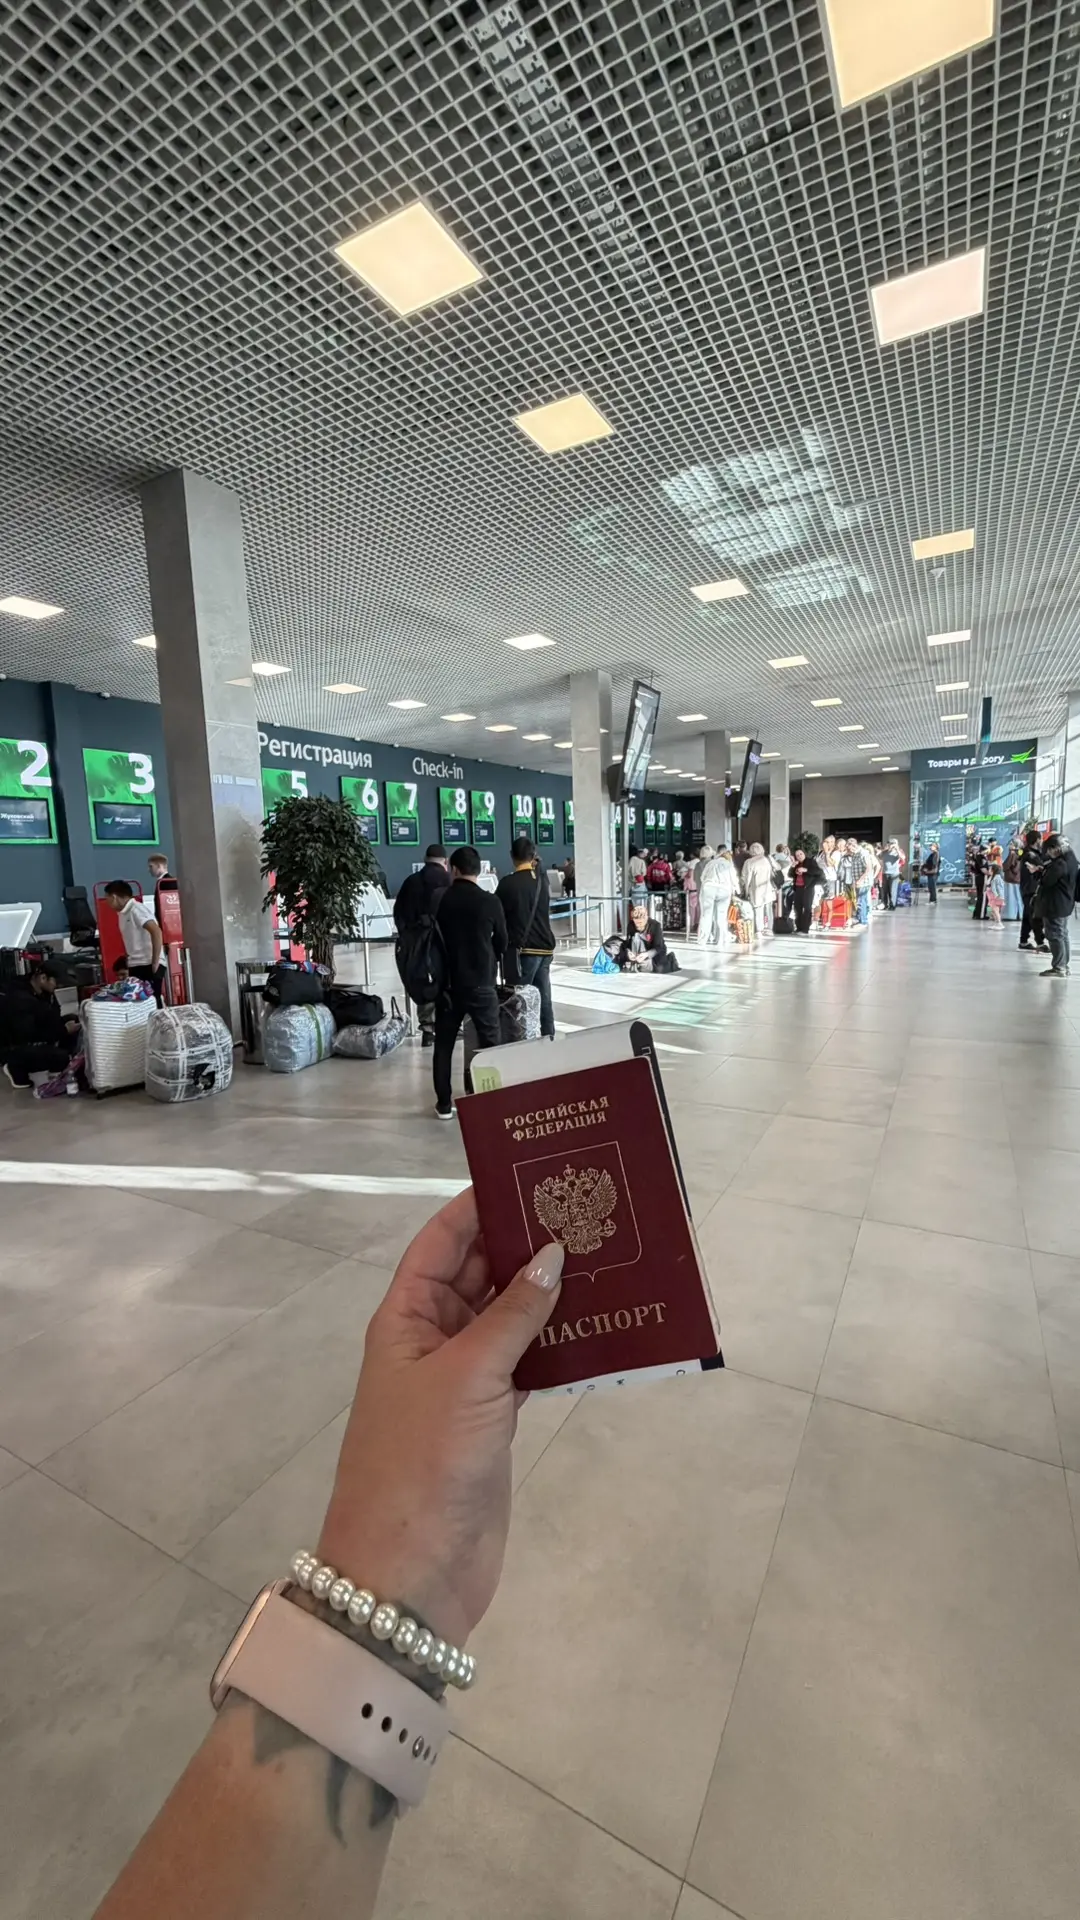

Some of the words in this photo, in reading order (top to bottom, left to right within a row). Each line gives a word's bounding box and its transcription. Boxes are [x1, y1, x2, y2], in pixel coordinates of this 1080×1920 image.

[17, 740, 52, 787] 2
[257, 731, 373, 770] Регистрация
[927, 759, 962, 769] Товары
[963, 758, 969, 766] в
[970, 755, 1005, 766] дрогу
[128, 752, 155, 794] 3
[412, 757, 464, 780] Check-in
[291, 769, 309, 800] 5
[361, 778, 379, 811] 6
[404, 783, 418, 811] 7
[455, 788, 467, 814] 8
[484, 791, 495, 816] 9
[515, 794, 533, 818] 10
[540, 797, 555, 820] 11
[568, 800, 575, 821] 1
[645, 809, 656, 826] 16
[658, 810, 667, 827] 17
[504, 1096, 610, 1130] РОССИЙСКАЯ
[512, 1111, 607, 1142] ФЕДЕРАЦИЯ
[540, 1302, 667, 1348] ПАСПОРТ
